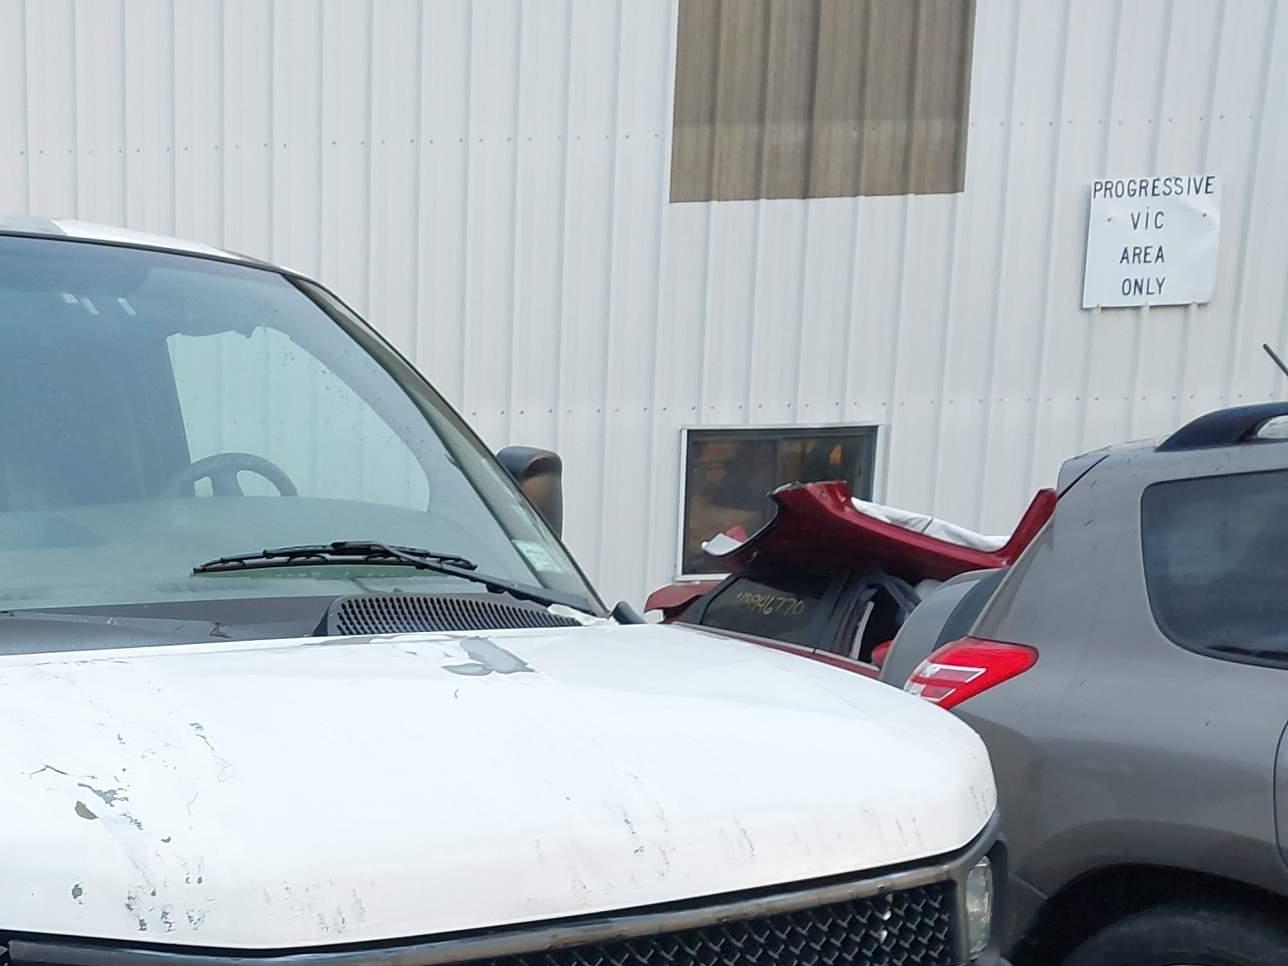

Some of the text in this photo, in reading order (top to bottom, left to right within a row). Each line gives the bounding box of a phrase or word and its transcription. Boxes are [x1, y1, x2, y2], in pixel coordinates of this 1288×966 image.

[1093, 176, 1216, 199] PROGRESSIVE
[1130, 210, 1165, 230] VIC
[1119, 245, 1165, 264] AREA
[1121, 277, 1166, 296] ONLY
